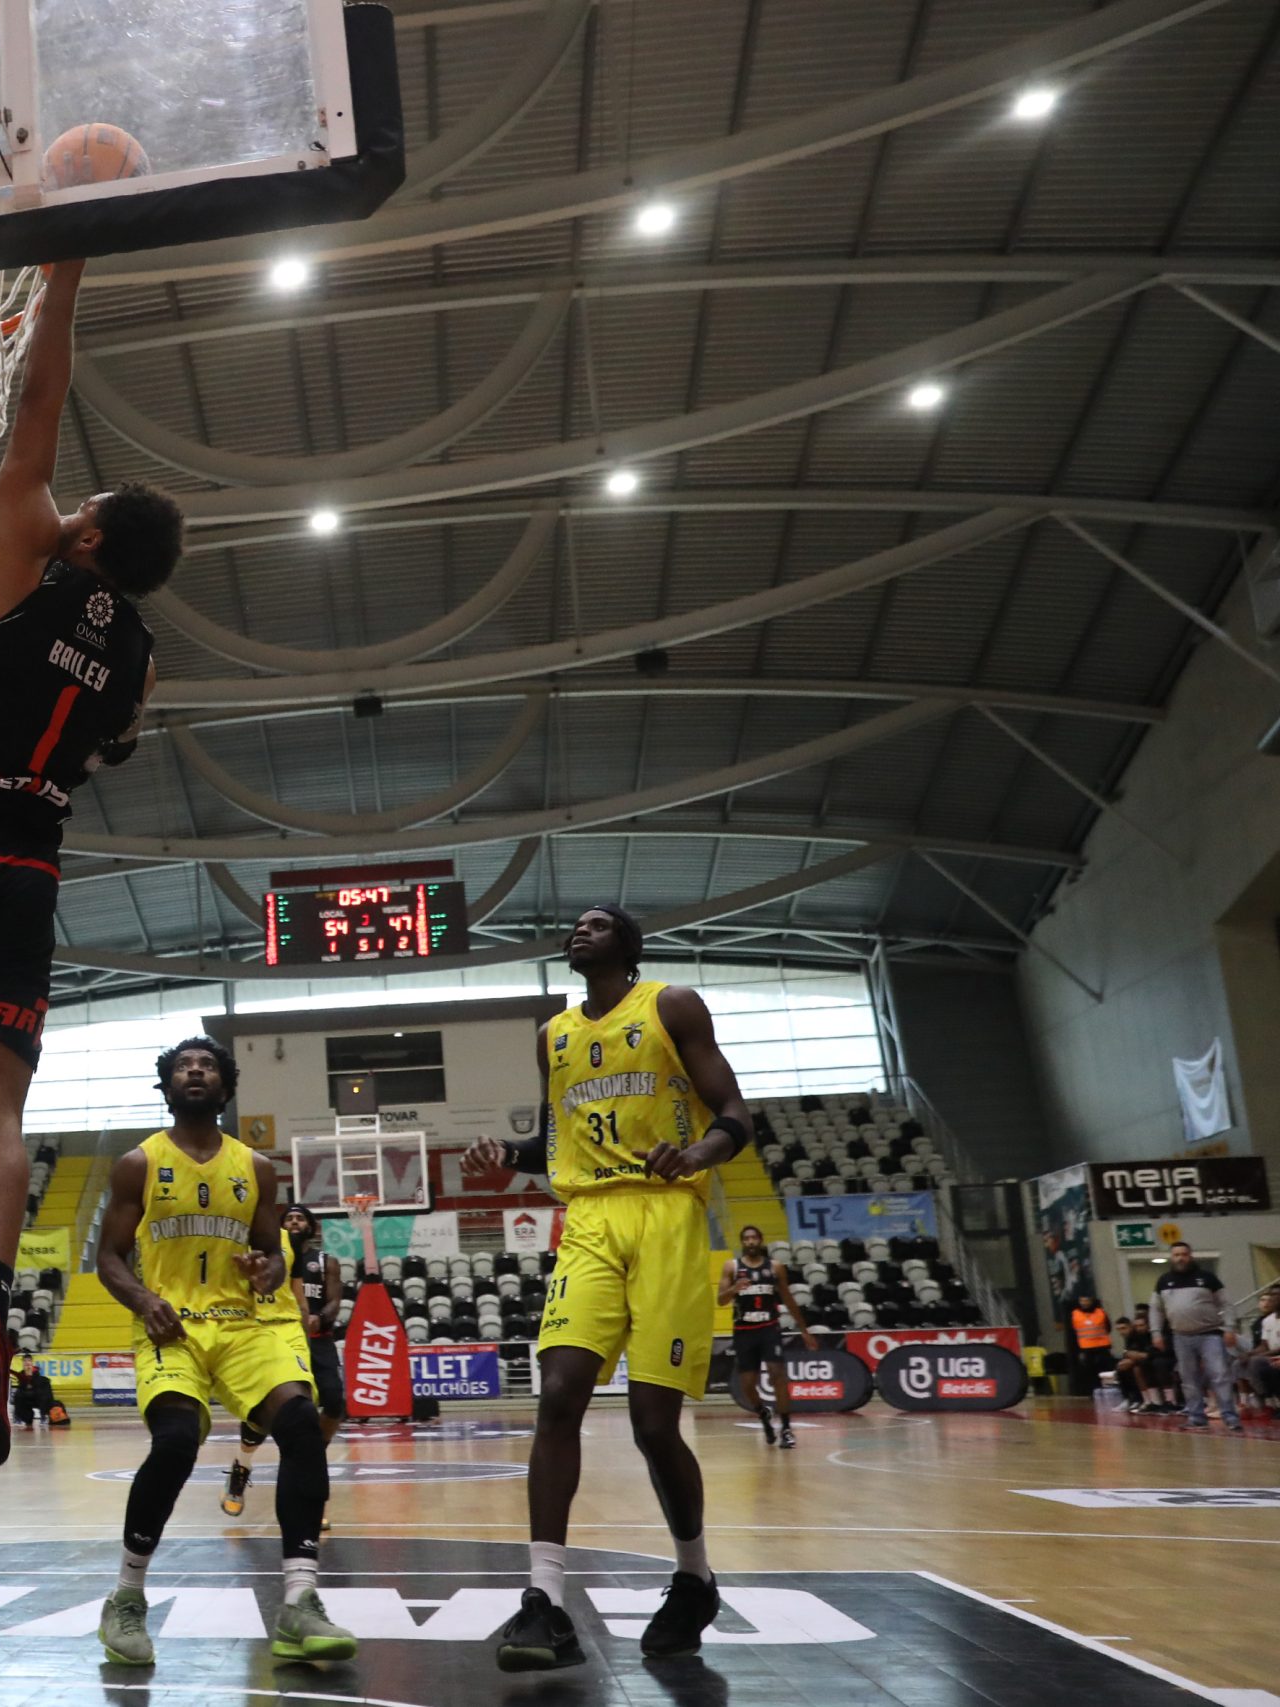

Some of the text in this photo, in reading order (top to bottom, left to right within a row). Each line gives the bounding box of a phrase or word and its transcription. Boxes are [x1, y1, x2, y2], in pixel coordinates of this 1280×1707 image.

[76, 622, 108, 648] OVAR
[48, 639, 111, 692] BAILEY
[28, 685, 81, 774] 1
[338, 886, 389, 906] 05:47
[319, 910, 346, 919] LOCAL
[388, 914, 413, 932] 47
[324, 919, 349, 937] 54
[587, 1110, 619, 1146] 31
[1102, 1166, 1201, 1189] MEIA
[1115, 1186, 1203, 1208] LUA
[513, 1226, 536, 1236] ERA
[198, 1250, 207, 1285] 1
[352, 1320, 398, 1407] GAVEX
[787, 1360, 834, 1380] LIGA
[937, 1357, 986, 1378] LIGA
[412, 1378, 490, 1397] COLCHÕES
[791, 1384, 838, 1397] Betclic
[941, 1382, 991, 1395] Betclic
